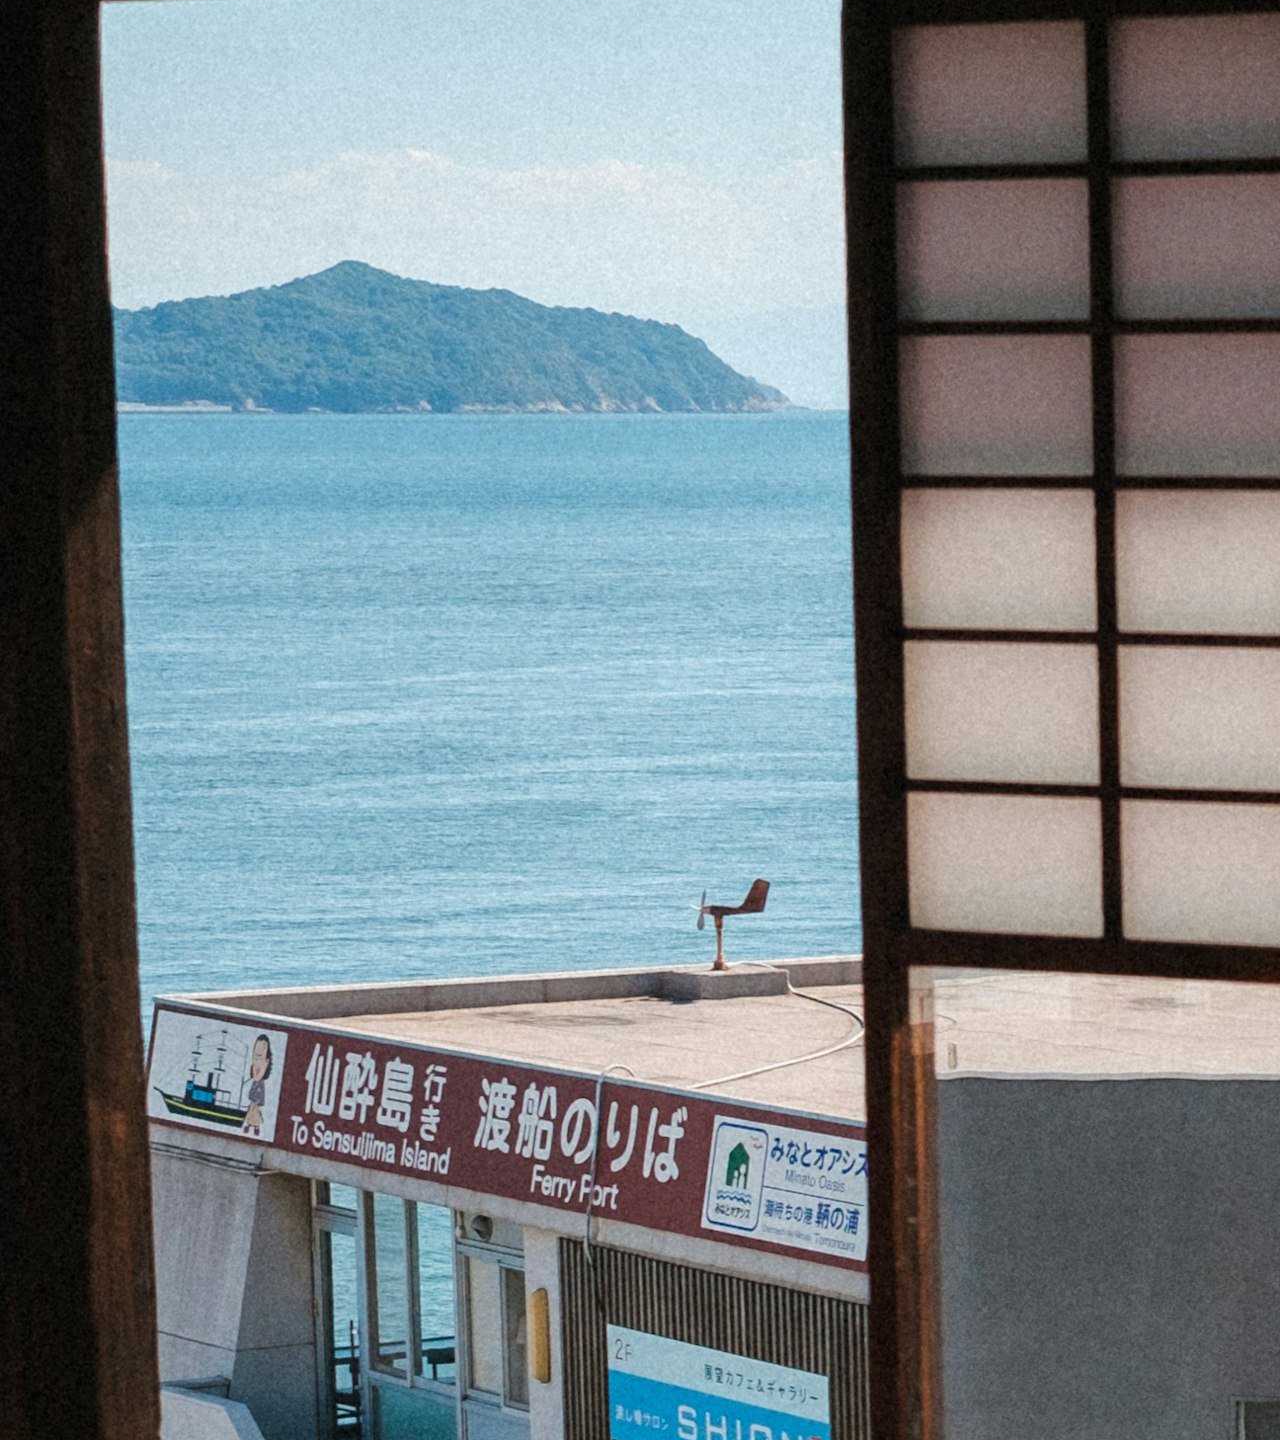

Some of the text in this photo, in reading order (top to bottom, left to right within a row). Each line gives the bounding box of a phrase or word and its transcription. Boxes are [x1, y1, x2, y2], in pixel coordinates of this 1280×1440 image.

[291, 1115, 451, 1175] To Sensuijima Island
[474, 1077, 688, 1183] 渡船のりば
[770, 1137, 868, 1178] みなとオアシス
[530, 1164, 620, 1210] Ferry Port
[785, 1169, 846, 1193] Minato Oasis
[615, 1339, 632, 1362] 2F
